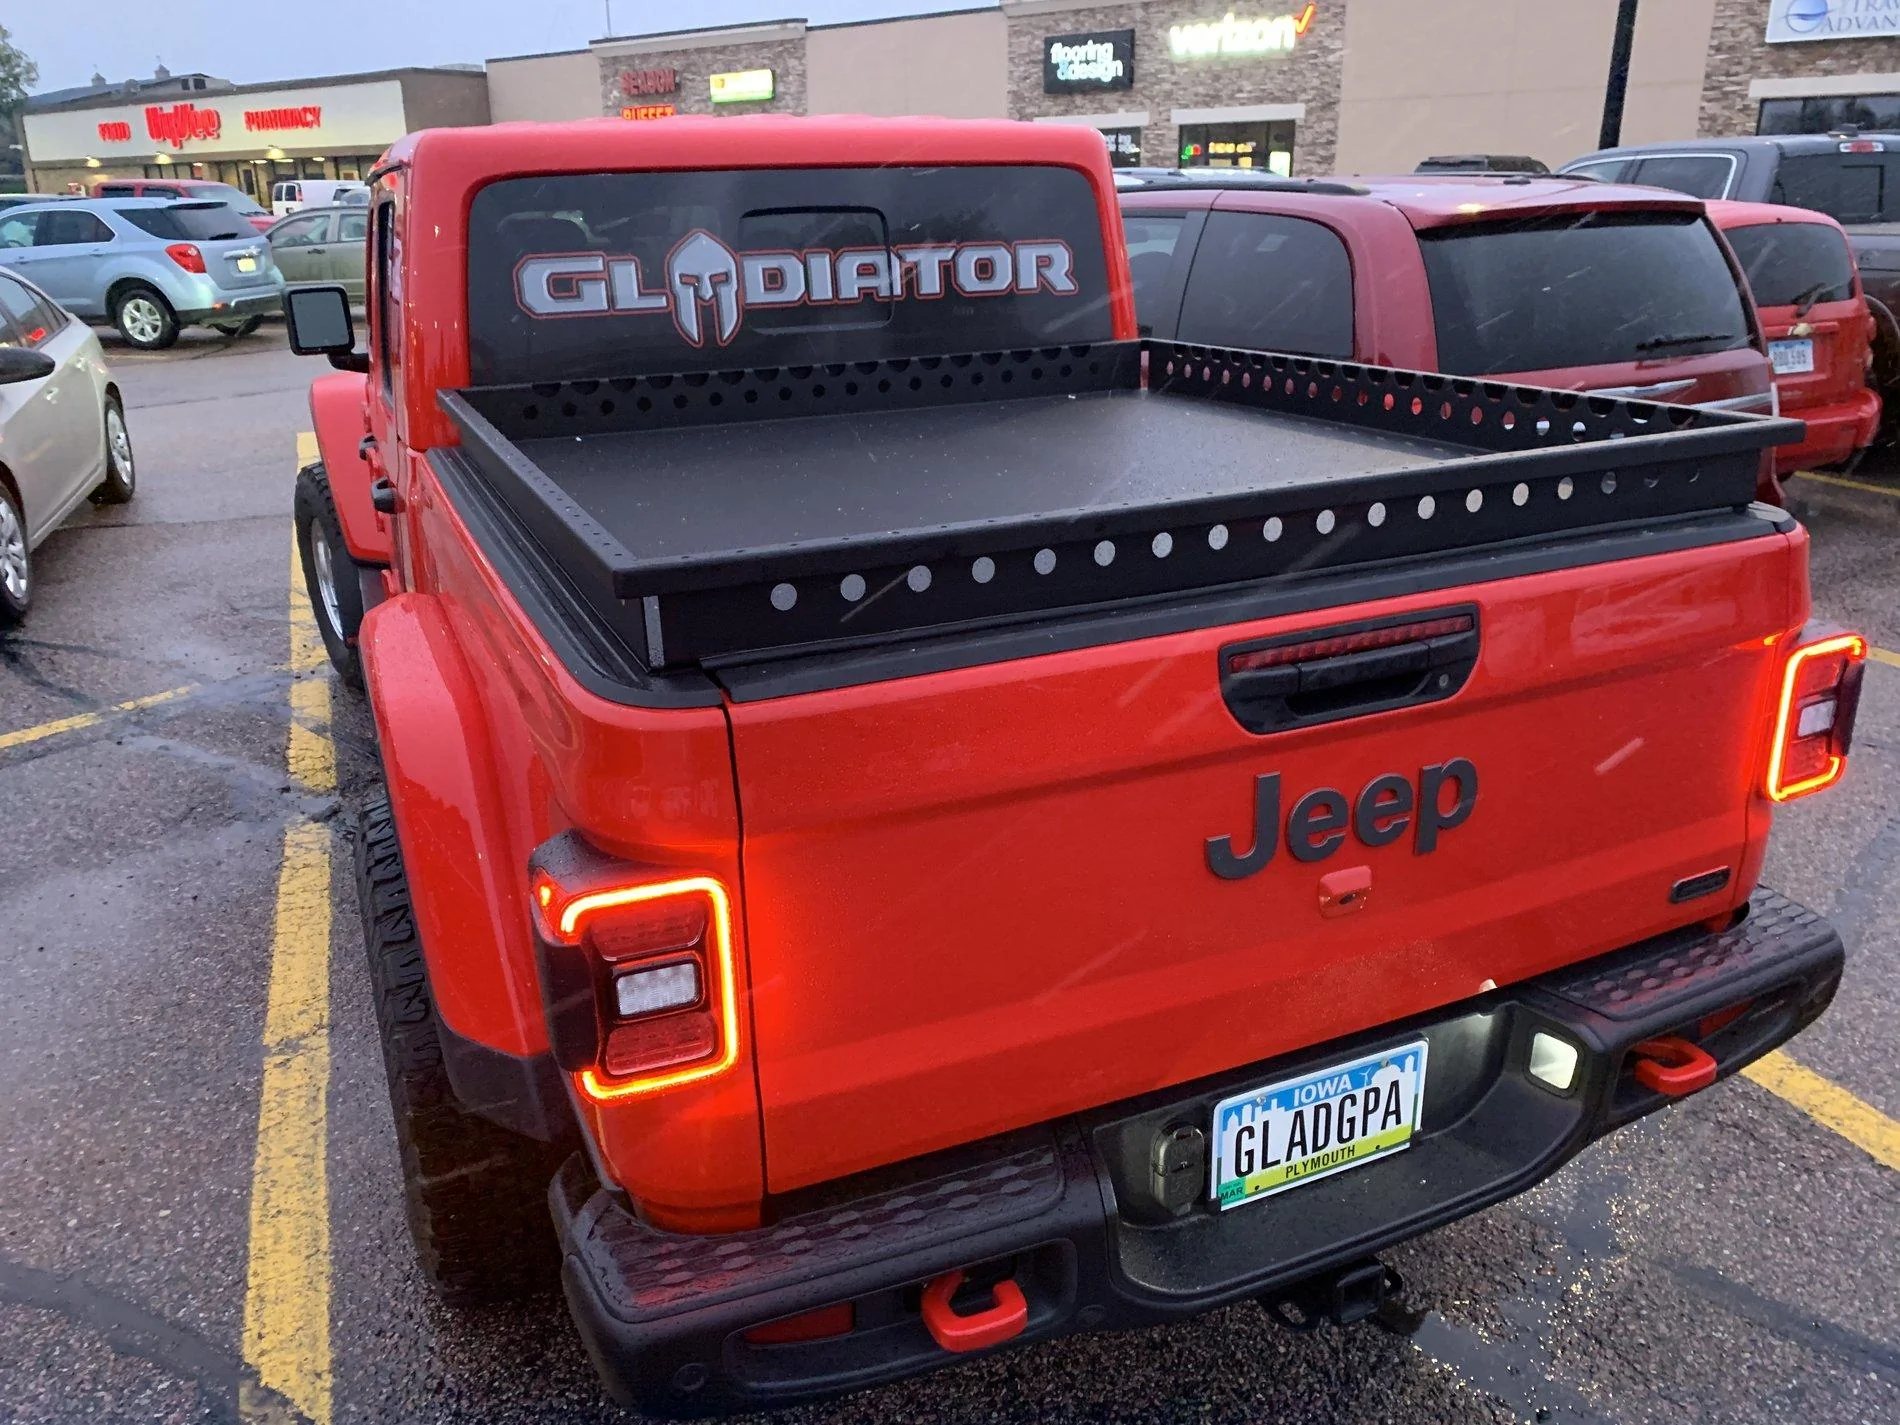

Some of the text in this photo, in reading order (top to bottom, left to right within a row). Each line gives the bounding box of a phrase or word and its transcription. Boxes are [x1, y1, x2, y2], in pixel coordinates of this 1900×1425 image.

[1169, 12, 1296, 56] verizon
[1050, 40, 1114, 65] flooring
[244, 106, 321, 131] PHARMACY
[1204, 757, 1478, 880] Jeep
[1294, 1073, 1353, 1107] IOWA
[1234, 1079, 1402, 1178] GLADGPA
[1285, 1144, 1356, 1179] PLYMOUTH
[1220, 1186, 1244, 1200] MAR
